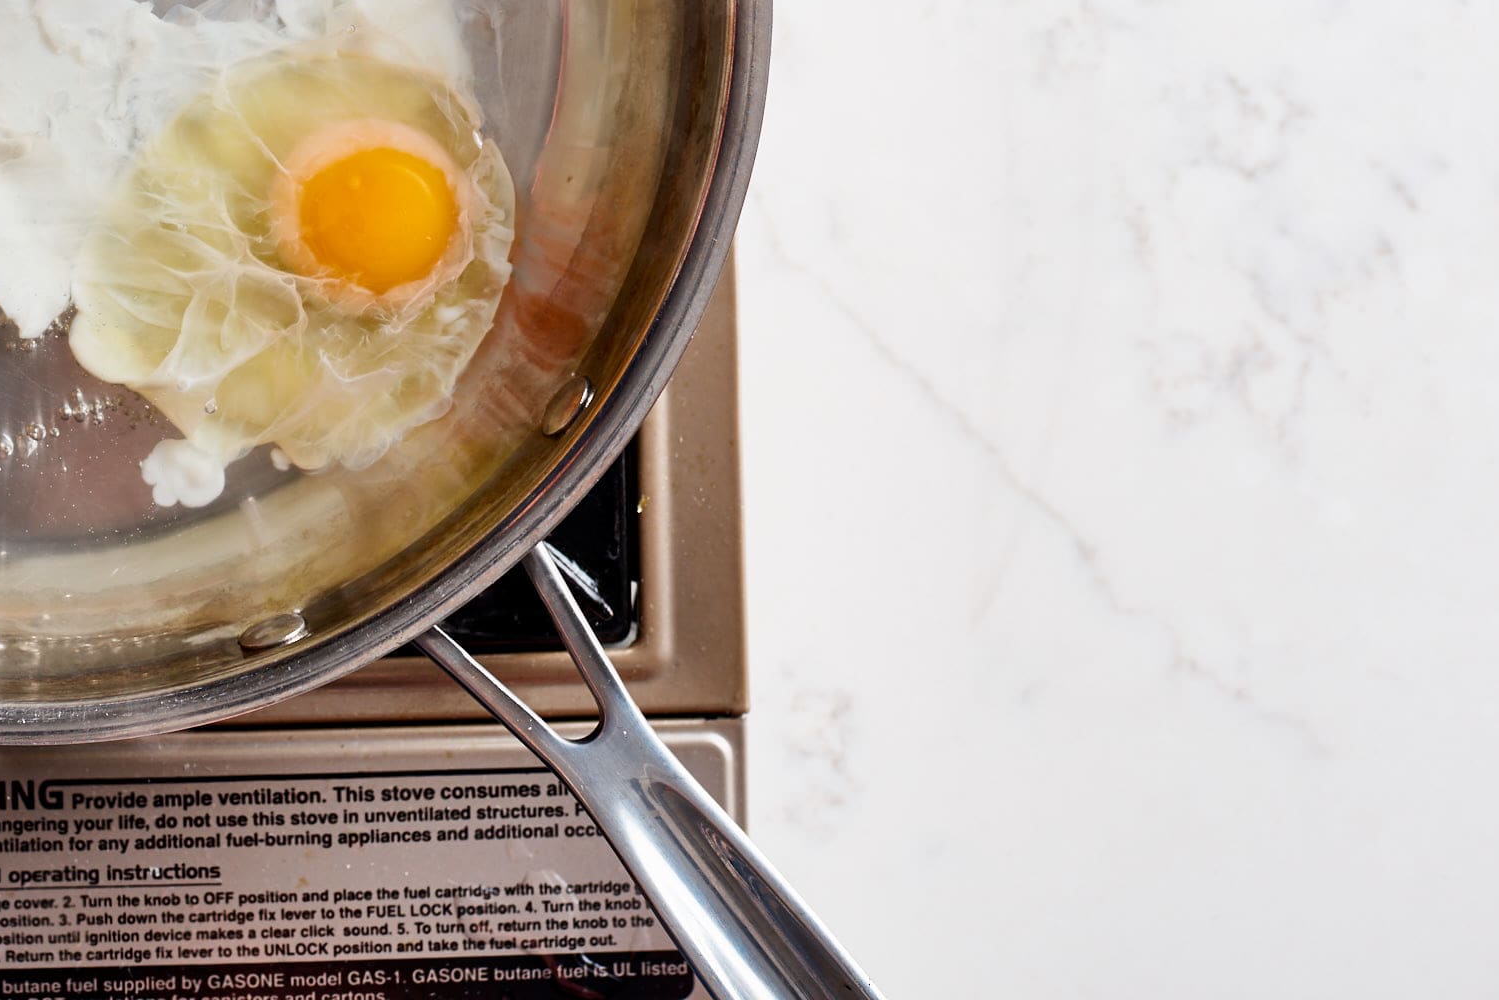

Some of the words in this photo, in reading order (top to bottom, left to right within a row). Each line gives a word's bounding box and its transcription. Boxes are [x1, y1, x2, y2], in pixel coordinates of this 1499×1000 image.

[71, 791, 148, 810] Provide
[152, 789, 213, 809] ample
[217, 787, 326, 806] ventilation.
[332, 785, 375, 803] This
[380, 785, 435, 802] stove
[440, 784, 541, 800] consumes
[73, 818, 114, 834] your
[118, 814, 150, 831] life,
[154, 813, 178, 829] do
[182, 812, 211, 828] not
[216, 814, 248, 827] use
[252, 811, 285, 826] this
[290, 811, 338, 825] stove
[343, 809, 358, 824] in
[364, 805, 471, 823] unventilated
[476, 804, 569, 820] structures.
[68, 836, 94, 851] for
[98, 838, 129, 853] any
[134, 832, 220, 850] additional
[225, 830, 332, 849] fuel-burning
[337, 828, 432, 848] appliances
[436, 826, 468, 841] and
[474, 823, 559, 840] additional
[8, 865, 100, 887] operating
[106, 862, 221, 881] instructions
[13, 898, 58, 910] cover.
[80, 894, 112, 908] Turn
[116, 894, 140, 907] the
[144, 893, 181, 906] knob
[184, 893, 200, 906] to
[203, 891, 234, 905] OFF
[238, 890, 298, 907] position
[302, 889, 329, 902] and
[333, 888, 372, 904] place
[376, 887, 400, 900] the
[403, 886, 430, 899] fuel
[504, 883, 534, 896] with
[538, 882, 562, 895] the
[565, 881, 630, 896] cartridge
[58, 913, 71, 926] 3.
[76, 912, 113, 926] Push
[117, 912, 157, 925] down
[161, 911, 184, 924] the
[188, 909, 254, 924] cartridge
[258, 908, 276, 921] fix
[280, 908, 316, 921] lever
[320, 908, 335, 919] to
[338, 906, 362, 919] the
[366, 904, 406, 918] FUEL
[410, 903, 452, 917] LOCK
[456, 903, 520, 918] position.
[524, 901, 537, 913] 4.
[541, 900, 574, 913] Turn
[578, 899, 601, 912] the
[604, 897, 641, 910] knob
[48, 931, 80, 944] until
[84, 929, 139, 946] ignition
[144, 928, 192, 942] device
[196, 927, 244, 940] makes
[248, 929, 256, 939] a
[260, 926, 296, 939] clear
[300, 925, 334, 938] click
[343, 923, 392, 937] sound.
[397, 922, 409, 935] 5.
[414, 921, 431, 934] To
[435, 922, 466, 934] turn
[469, 919, 493, 933] off,
[497, 919, 541, 932] return
[545, 918, 568, 930] the
[572, 916, 608, 929] knob
[612, 916, 627, 928] to
[630, 915, 654, 927] the
[5, 949, 54, 963] Return
[58, 949, 82, 961] the
[85, 947, 151, 962] cartridge
[155, 946, 172, 959] fix
[177, 946, 213, 959] lever
[217, 946, 232, 958] to
[236, 944, 260, 957] the
[264, 942, 328, 956] UNLOCK
[333, 941, 392, 957] position
[396, 939, 423, 952] and
[428, 939, 458, 951] take
[462, 937, 486, 950] the
[488, 937, 517, 950] fuel
[520, 935, 586, 950] cartridge
[589, 934, 617, 946] out.
[2, 980, 61, 994] butane
[66, 978, 97, 992] fuel
[103, 976, 176, 994] supplied
[181, 975, 202, 992] by
[207, 973, 284, 989] GASONE
[290, 972, 342, 986] model
[412, 967, 488, 984] GASONE
[494, 967, 552, 980] butane
[556, 965, 588, 978] fuel
[613, 962, 636, 977] UL
[641, 961, 688, 976] listed
